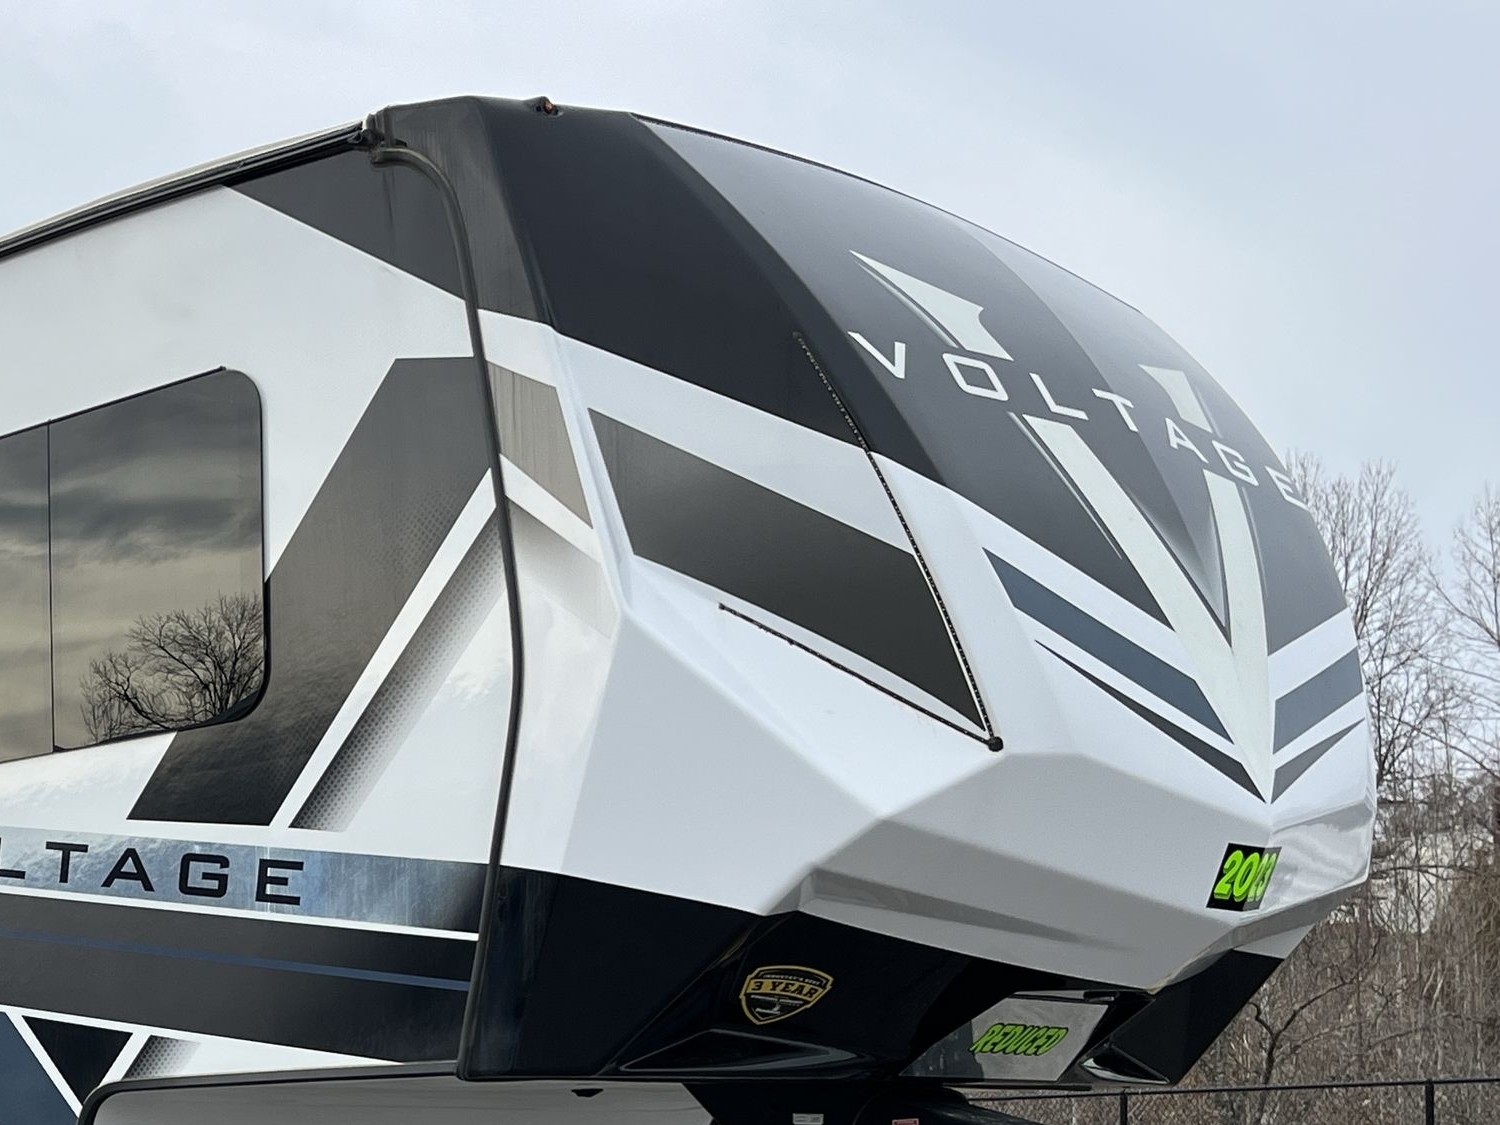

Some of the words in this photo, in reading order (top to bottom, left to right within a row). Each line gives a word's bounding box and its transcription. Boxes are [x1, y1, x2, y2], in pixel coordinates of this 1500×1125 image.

[847, 330, 1310, 510] VOLTAGE
[751, 981, 764, 992] 3
[770, 981, 818, 998] YEAR
[968, 1022, 1069, 1056] REDUCED
